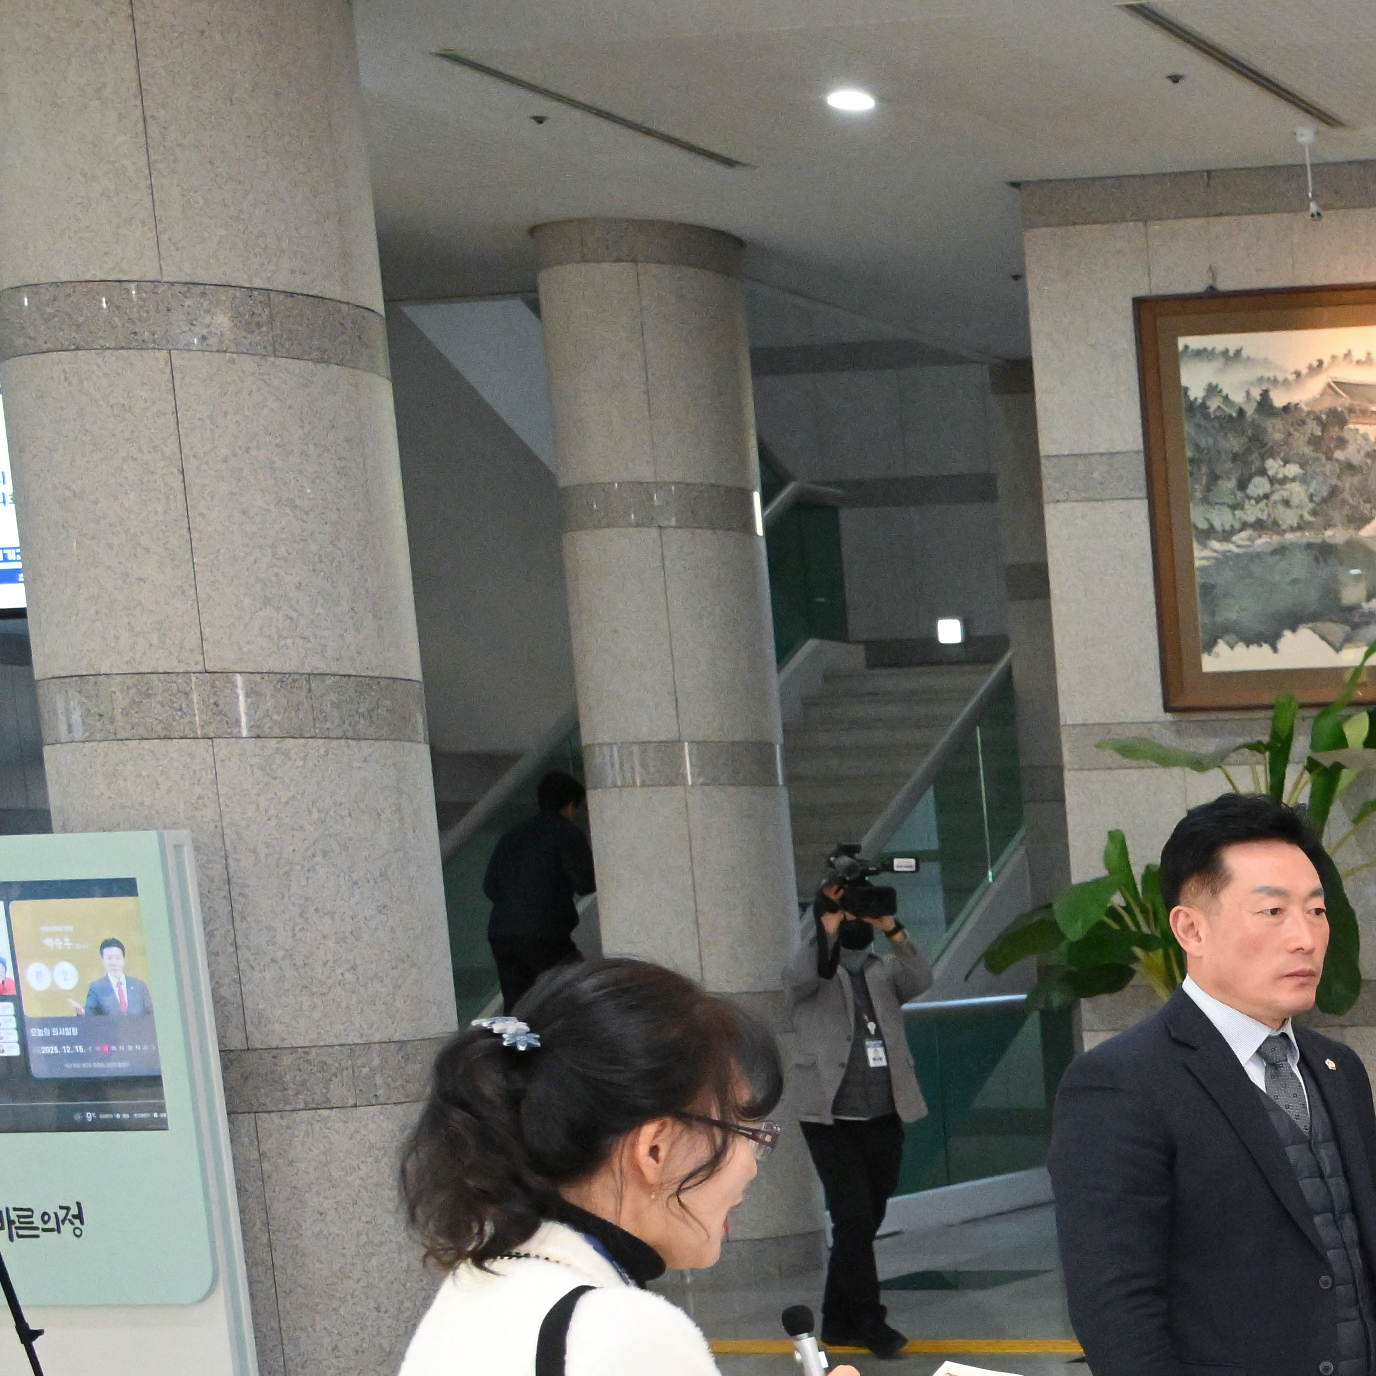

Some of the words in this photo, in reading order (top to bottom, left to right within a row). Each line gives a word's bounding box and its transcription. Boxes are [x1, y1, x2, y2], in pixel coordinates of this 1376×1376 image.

[41, 1045, 61, 1054] 2025.
[62, 1045, 74, 1054] 12.
[75, 1045, 86, 1053] 15.
